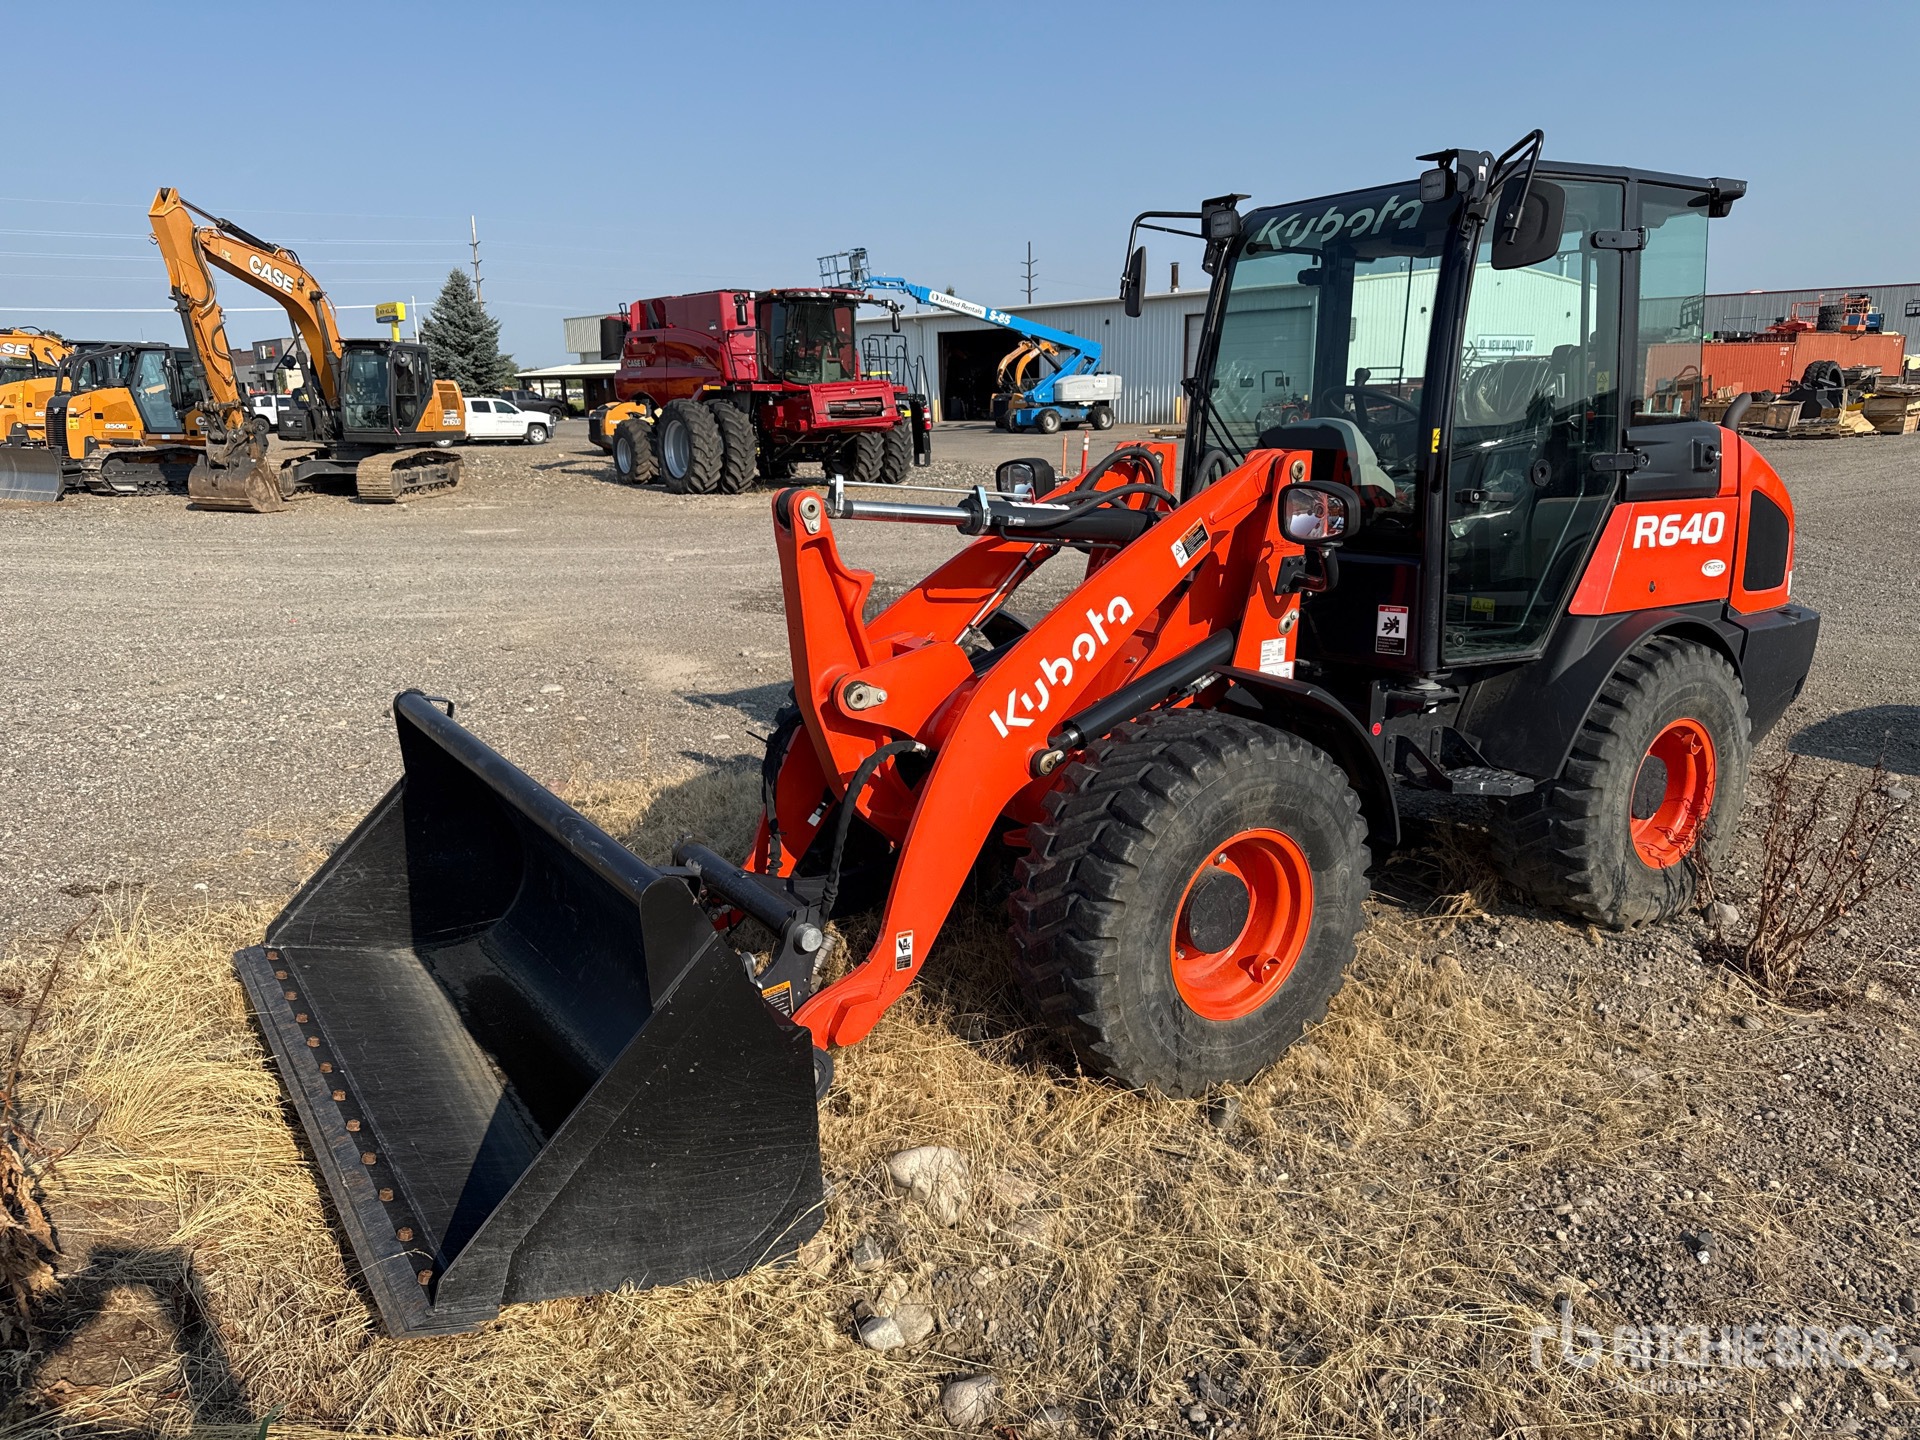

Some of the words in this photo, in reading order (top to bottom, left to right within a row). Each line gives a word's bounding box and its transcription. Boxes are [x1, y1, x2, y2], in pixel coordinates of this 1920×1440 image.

[1256, 194, 1424, 250] Kubota
[248, 254, 295, 295] CASE
[939, 296, 961, 308] United
[960, 302, 983, 316] Rentals
[988, 310, 1012, 326] S-85
[1488, 340, 1501, 352] NEW
[1502, 340, 1525, 352] HOLLAND
[1526, 340, 1534, 352] OF
[626, 359, 642, 367] CASE
[1632, 511, 1726, 550] R640
[988, 596, 1135, 740] Kubota
